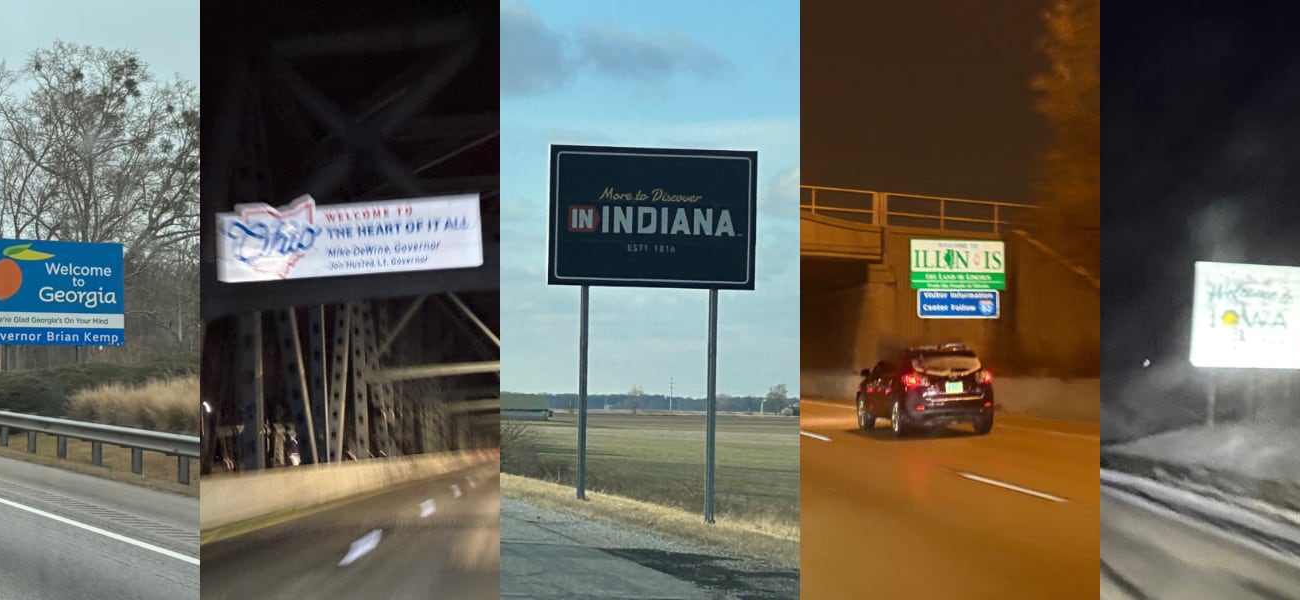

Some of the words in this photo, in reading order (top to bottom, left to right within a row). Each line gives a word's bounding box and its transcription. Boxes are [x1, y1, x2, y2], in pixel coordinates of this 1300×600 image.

[599, 187, 632, 201] More
[635, 190, 650, 201] to
[652, 188, 703, 203] Discover
[325, 207, 390, 222] WELCOME
[396, 205, 414, 217] TO
[571, 208, 594, 229] IN
[601, 205, 736, 237] INDIANA
[327, 226, 354, 239] THE
[354, 221, 401, 239] HEART
[405, 220, 423, 234] OF
[426, 219, 440, 232] IT
[443, 216, 470, 231] ALL
[223, 218, 323, 263] Ohio
[328, 247, 351, 257] Mike
[394, 240, 441, 253] Governor
[654, 244, 676, 253] 1816
[45, 262, 112, 277] Welcome
[329, 260, 344, 270] Jon
[391, 255, 429, 266] Governor
[72, 276, 85, 287] to
[39, 286, 117, 308] Georgia
[922, 303, 949, 311] Center
[31, 317, 63, 325] Georgia's
[92, 317, 109, 325] Mind
[46, 330, 79, 342] Brian
[84, 332, 119, 345] Kemp
